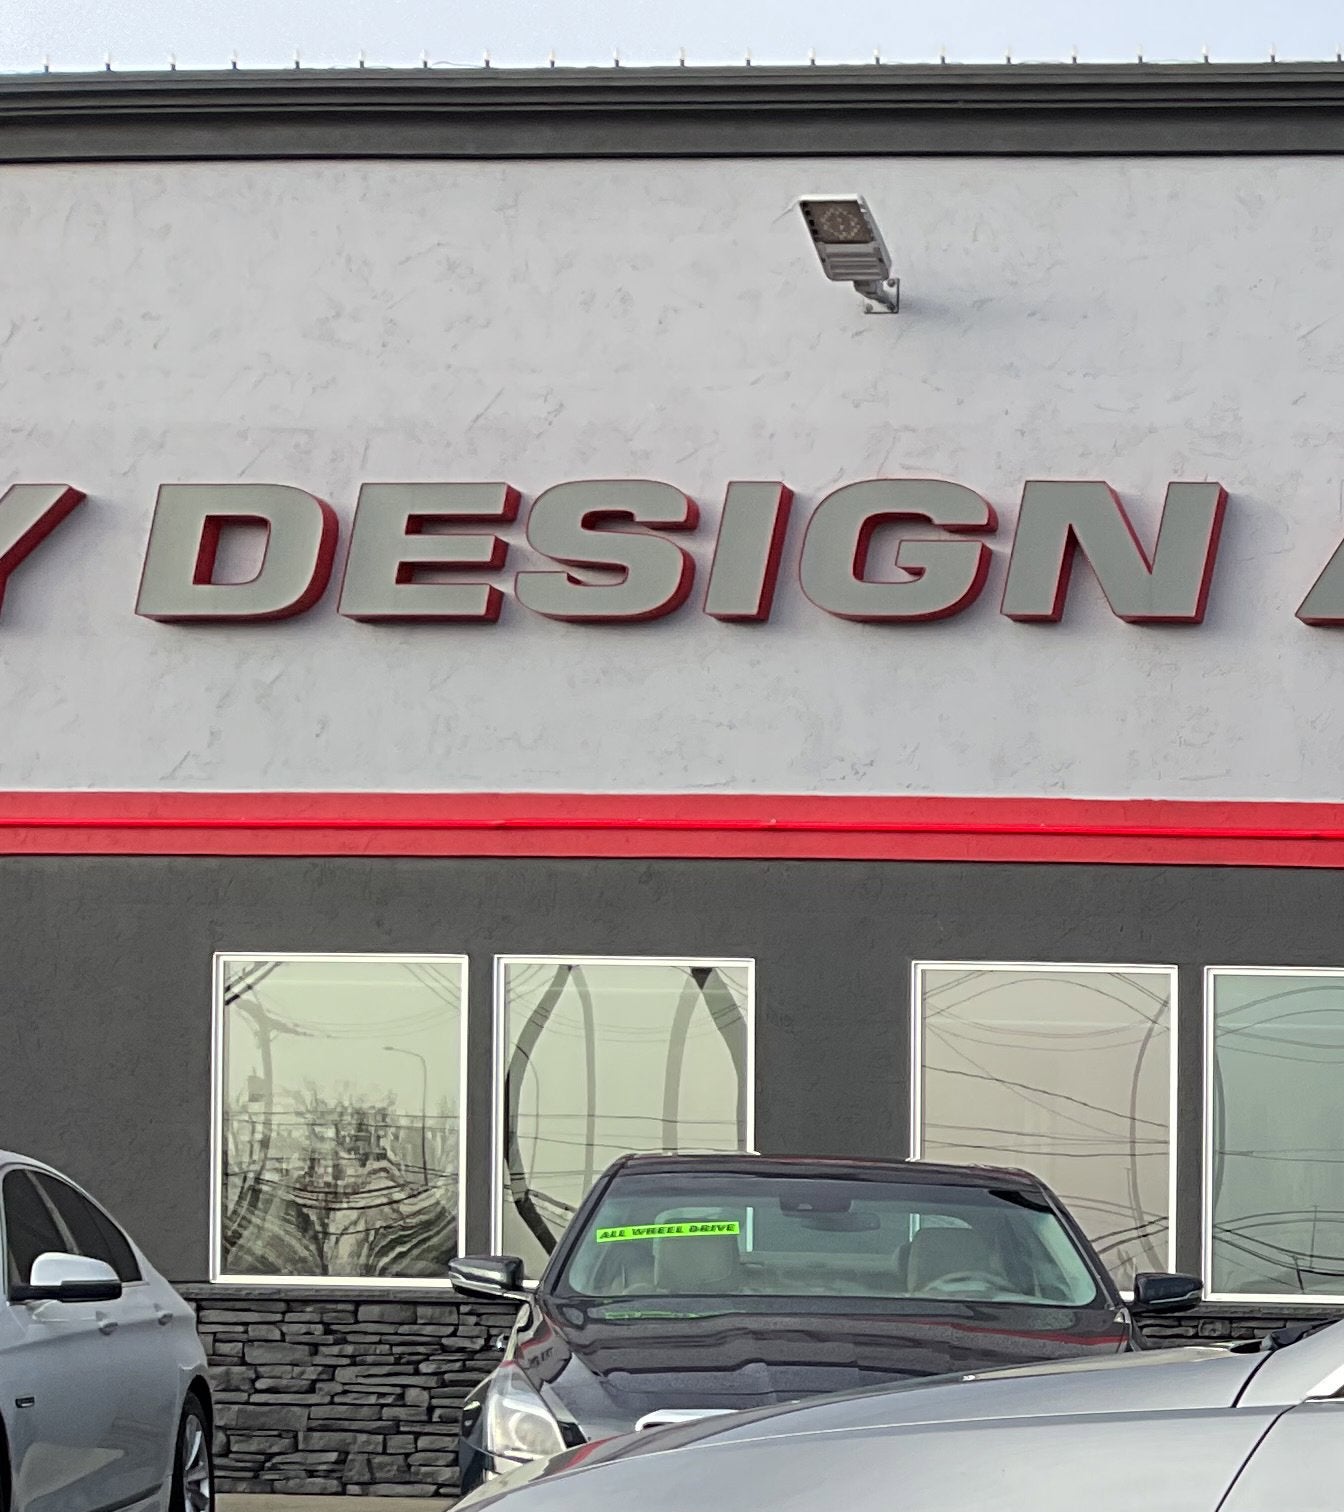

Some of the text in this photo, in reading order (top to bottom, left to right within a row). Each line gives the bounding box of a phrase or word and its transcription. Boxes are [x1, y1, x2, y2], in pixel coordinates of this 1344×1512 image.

[135, 478, 1236, 625] DESIGN
[599, 1223, 736, 1239] ALL WHEEL DRIVE
